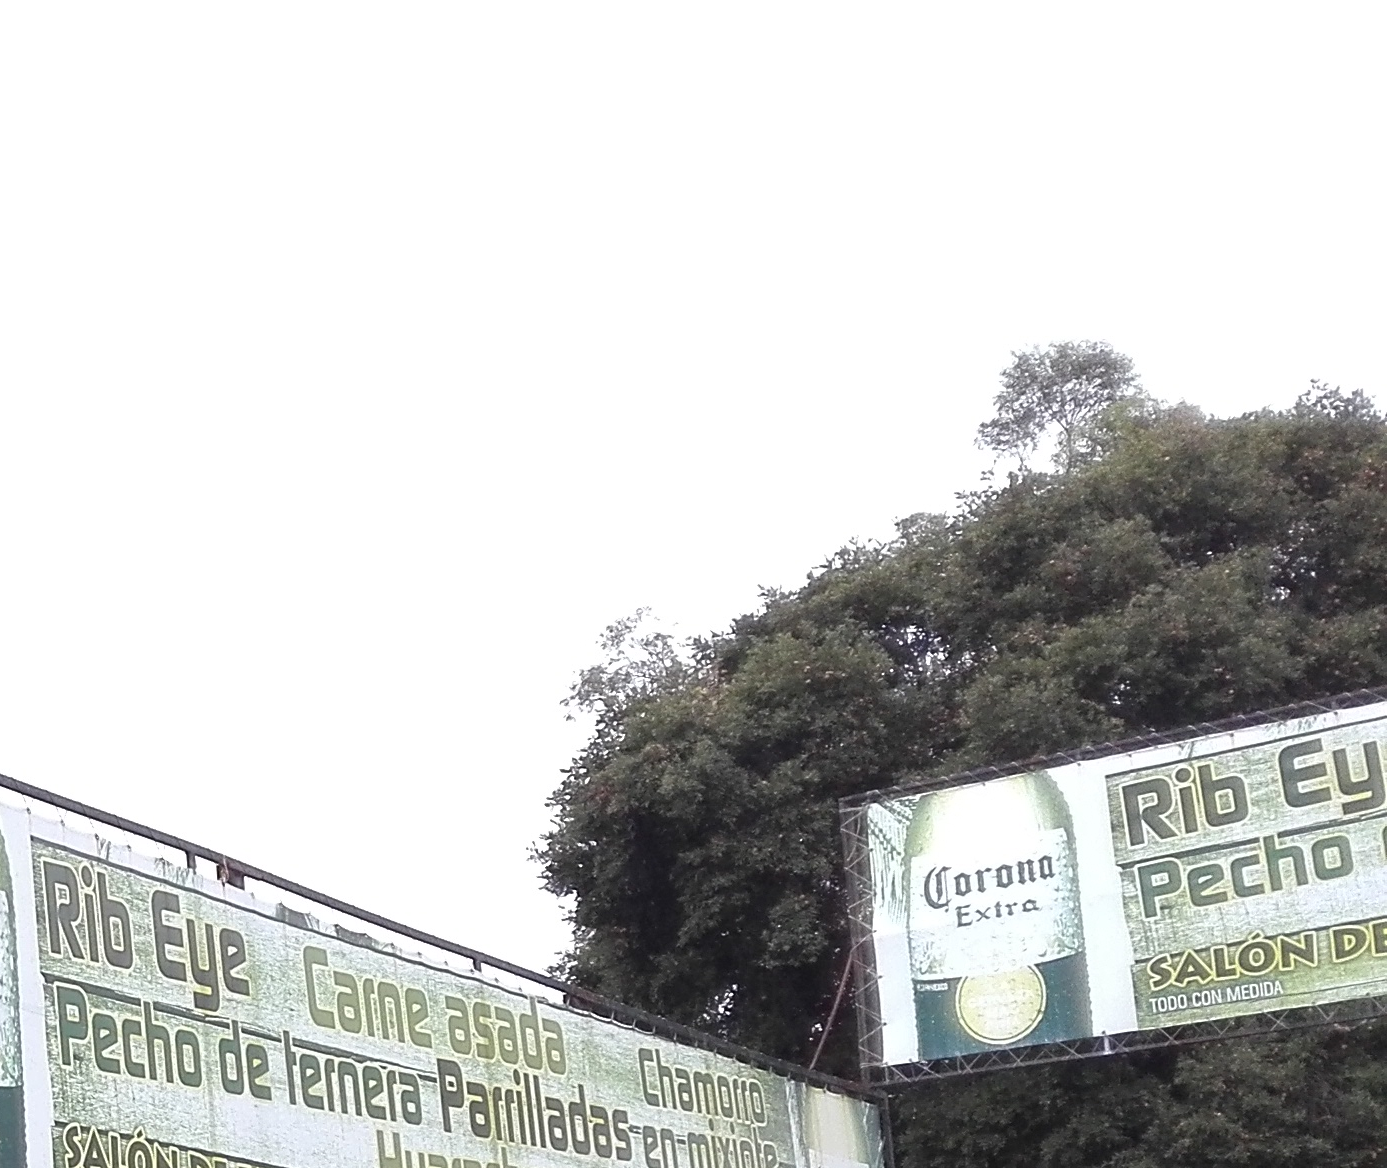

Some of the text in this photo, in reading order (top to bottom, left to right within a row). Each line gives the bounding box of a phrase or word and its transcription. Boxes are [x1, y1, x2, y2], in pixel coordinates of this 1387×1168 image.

[1121, 737, 1387, 849] Rib Ey
[924, 852, 1056, 912] Corona
[955, 897, 1040, 929] Extra
[1136, 832, 1355, 919] Pecho
[40, 857, 252, 1013] Rib Eye
[1147, 929, 1318, 991] SALÓN
[301, 943, 568, 1076] Carne asada
[1149, 980, 1284, 1013] TODO CON MEDIDA
[52, 981, 423, 1127] Pecho de ternera
[637, 1047, 767, 1126] Chamorro
[435, 1056, 632, 1163] Parrilladas
